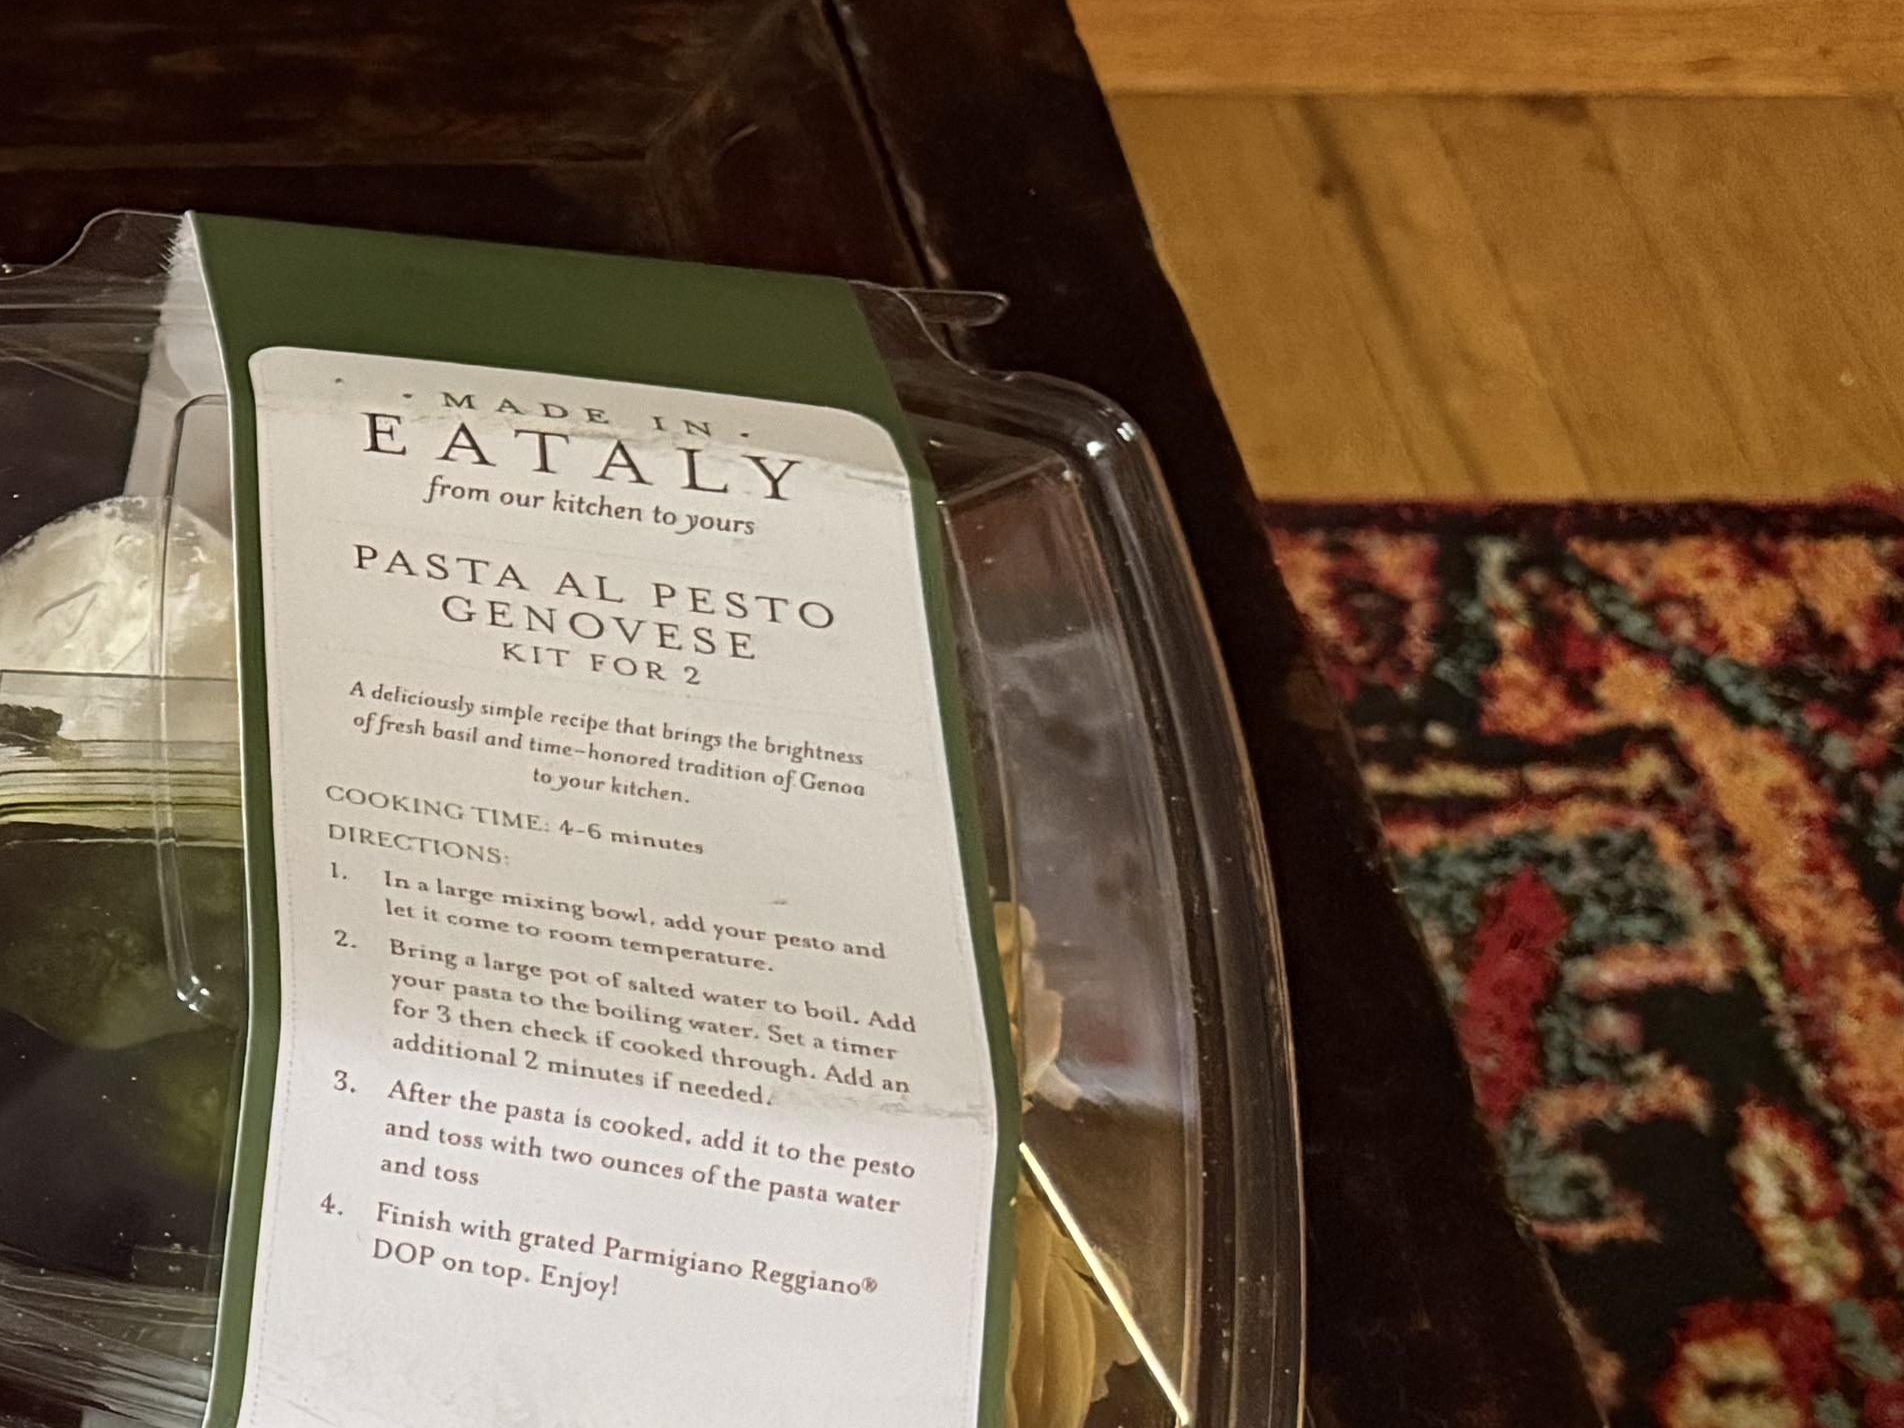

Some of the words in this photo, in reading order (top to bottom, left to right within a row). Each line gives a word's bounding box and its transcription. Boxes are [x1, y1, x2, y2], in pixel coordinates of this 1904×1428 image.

[441, 391, 609, 424] MADE
[650, 416, 713, 440] IN
[360, 412, 803, 501] EATALY
[422, 474, 490, 504] from
[499, 491, 546, 508] our
[552, 489, 642, 522] kitchen
[654, 505, 677, 525] to
[674, 514, 755, 535] yours
[352, 544, 530, 592] PASTA
[552, 571, 626, 603] AL
[651, 582, 834, 629] PESTO
[441, 595, 755, 660] GENOVESE
[501, 642, 571, 668] KIT
[589, 653, 667, 681] FOR
[683, 665, 701, 685] 2
[353, 712, 377, 734] of
[376, 714, 425, 736] fresh
[432, 720, 480, 743] basil
[484, 732, 524, 750] and
[678, 757, 766, 783] tradition
[772, 768, 797, 793] of
[799, 771, 865, 796] Genoa
[533, 768, 552, 784] to
[550, 774, 606, 792] your
[611, 776, 690, 803] kitchen.
[325, 785, 466, 820] COOKING
[470, 806, 550, 832] TIME:
[558, 819, 602, 840] 4-6
[610, 830, 704, 855] minutes
[330, 861, 347, 880] 1.
[384, 870, 411, 889] In
[417, 881, 430, 892] a
[436, 877, 494, 906] large
[502, 892, 585, 921] mixing
[664, 913, 707, 933] add
[713, 924, 767, 941] your
[773, 933, 835, 952] pesto
[843, 942, 888, 959] and
[320, 1192, 343, 1216] 4.
[376, 1201, 452, 1233] Finish
[460, 1219, 511, 1242] with
[518, 1231, 595, 1255] grated
[602, 1236, 743, 1278] Parmigiano
[372, 1237, 435, 1266] DOP
[442, 1257, 474, 1274] on
[482, 1260, 531, 1287] top.
[539, 1263, 618, 1301] Enjoy!
